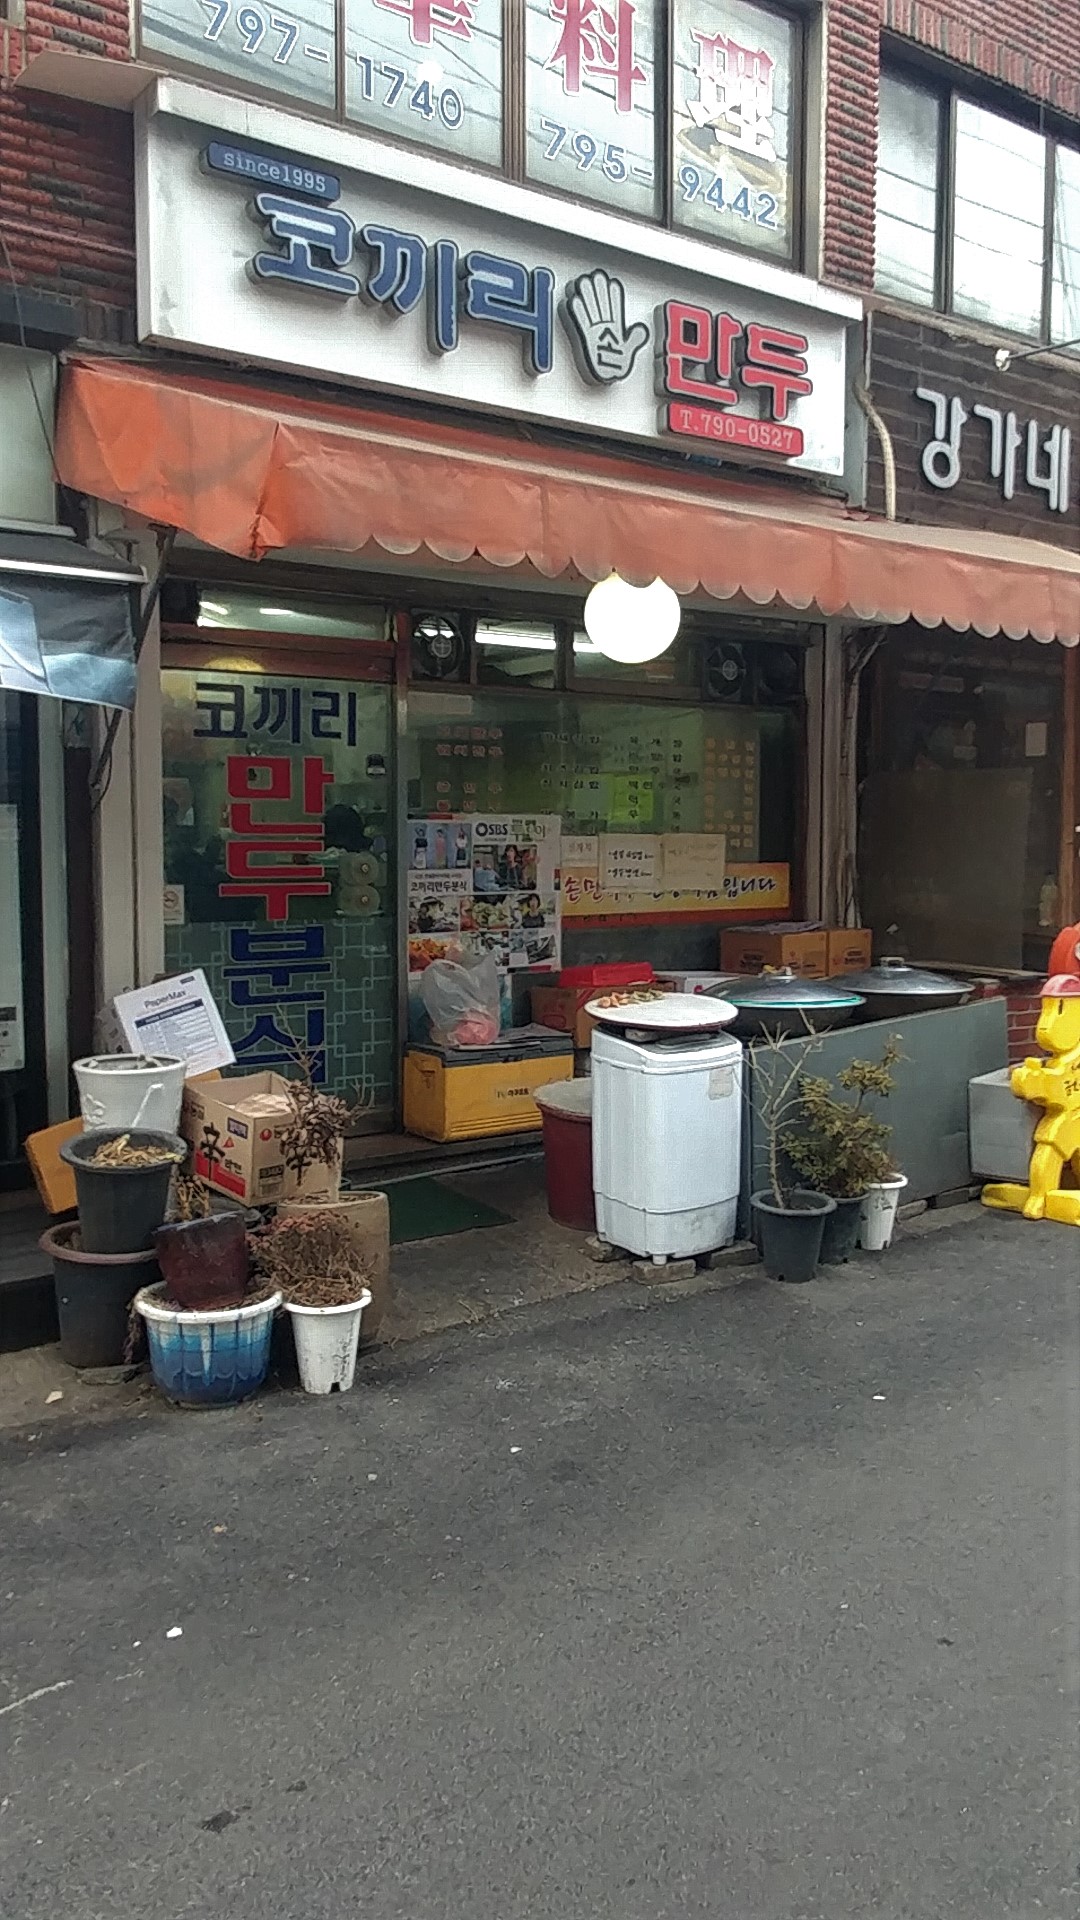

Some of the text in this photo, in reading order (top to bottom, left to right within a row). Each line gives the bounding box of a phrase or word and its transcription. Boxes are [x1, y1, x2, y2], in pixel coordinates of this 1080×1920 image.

[223, 152, 328, 193] since1995
[539, 116, 780, 231] 795- 9442
[254, 192, 556, 375] 코끼리
[664, 299, 813, 422] 만두
[679, 408, 796, 448] T.790-0527
[915, 386, 1072, 514] 강가네
[192, 681, 358, 747] 코끼리
[218, 754, 336, 922] 만두
[487, 823, 508, 836] SBS
[222, 923, 333, 1086] 분식
